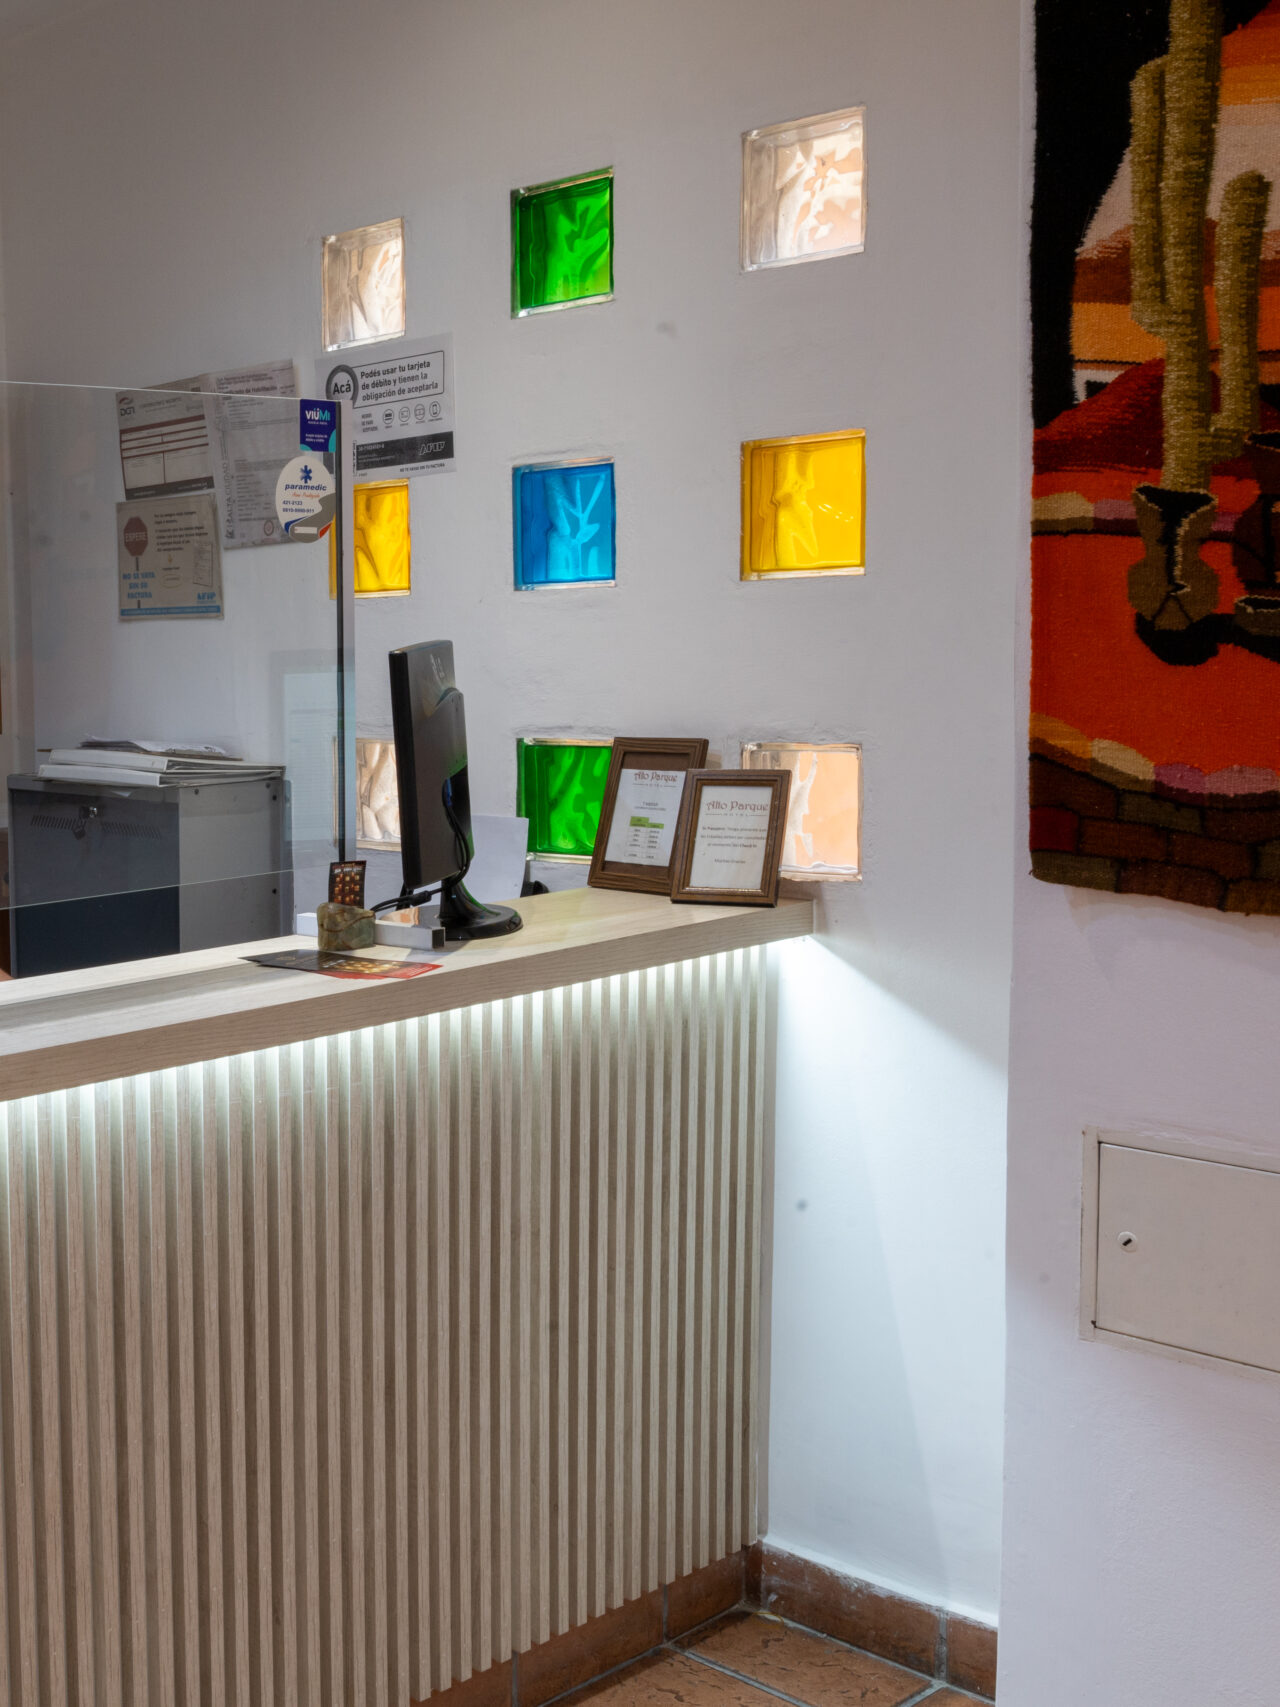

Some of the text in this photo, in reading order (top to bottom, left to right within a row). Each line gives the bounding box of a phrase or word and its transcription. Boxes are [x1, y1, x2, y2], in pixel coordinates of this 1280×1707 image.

[360, 360, 431, 379] Podés usar tu tarjeta
[332, 380, 352, 395] Acá
[361, 382, 370, 390] de
[371, 379, 392, 389] débito
[398, 374, 419, 384] tienen
[420, 371, 428, 380] la
[362, 381, 439, 401] obligación de aceptarla
[284, 483, 327, 492] paramedic
